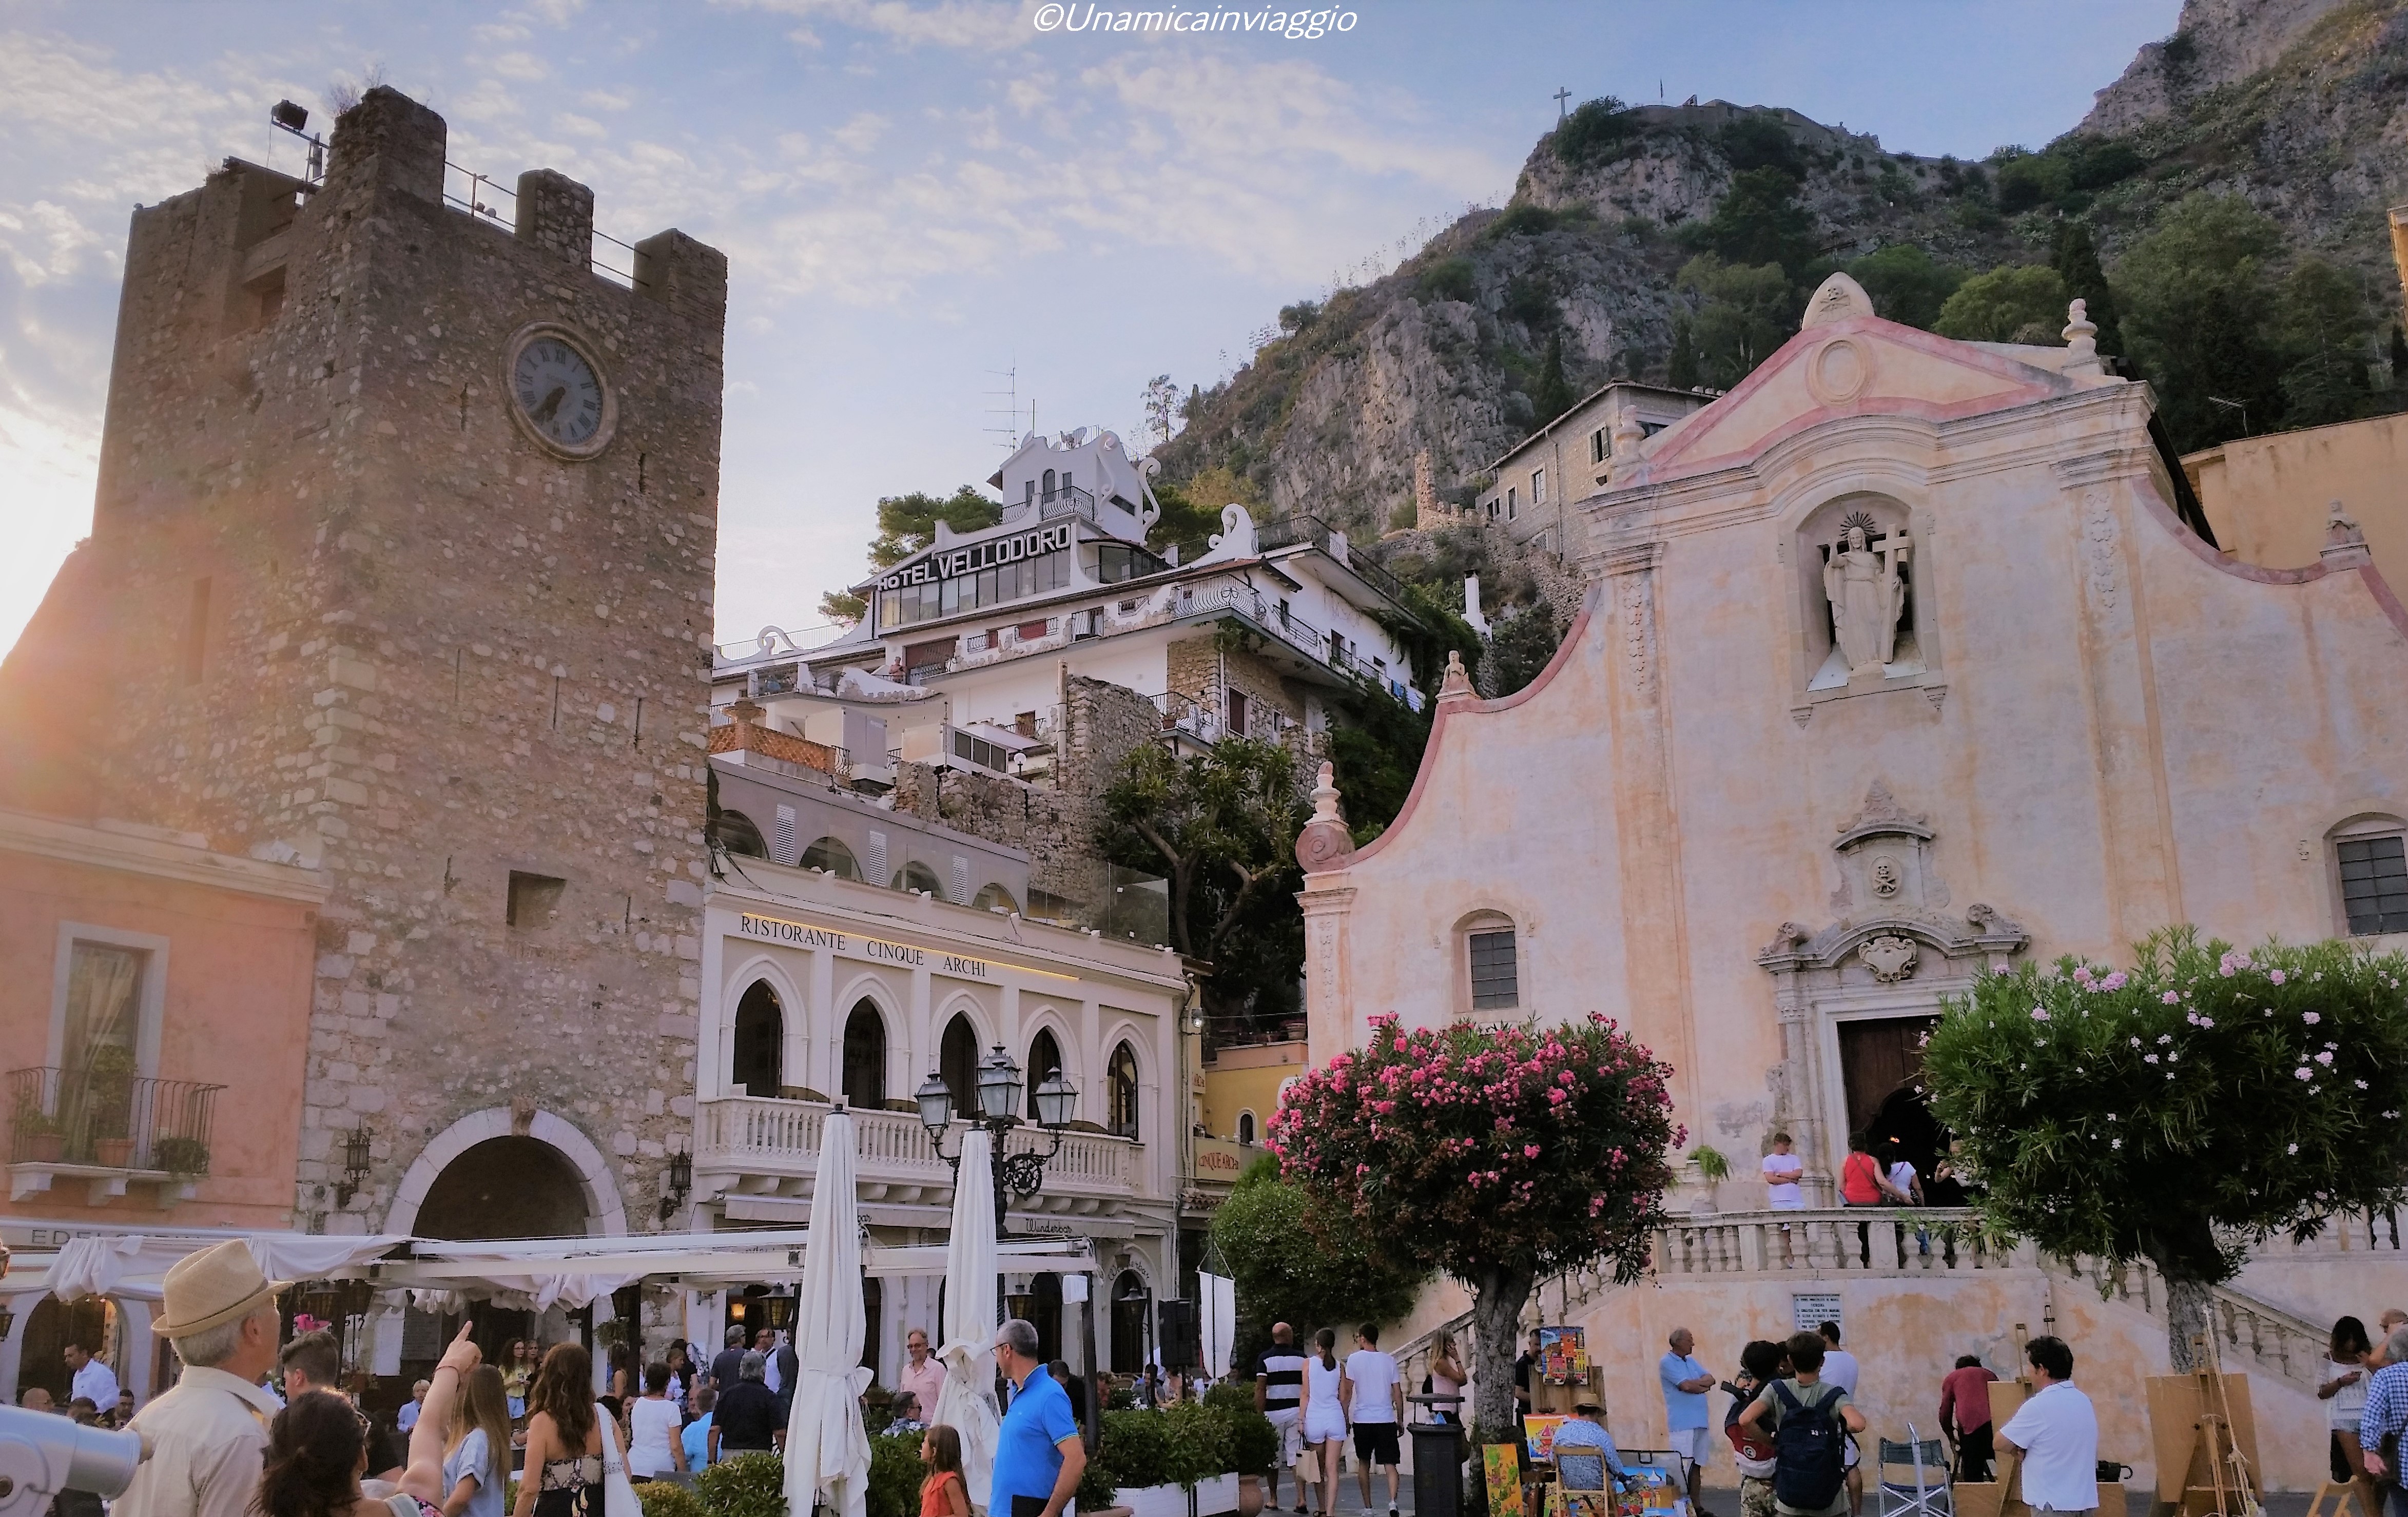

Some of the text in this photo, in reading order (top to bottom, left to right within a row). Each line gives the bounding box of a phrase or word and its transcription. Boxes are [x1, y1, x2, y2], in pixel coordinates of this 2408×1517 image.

[877, 562, 938, 590] HOTEL
[741, 915, 986, 977] RISTORANTE CINQUE ARCHI
